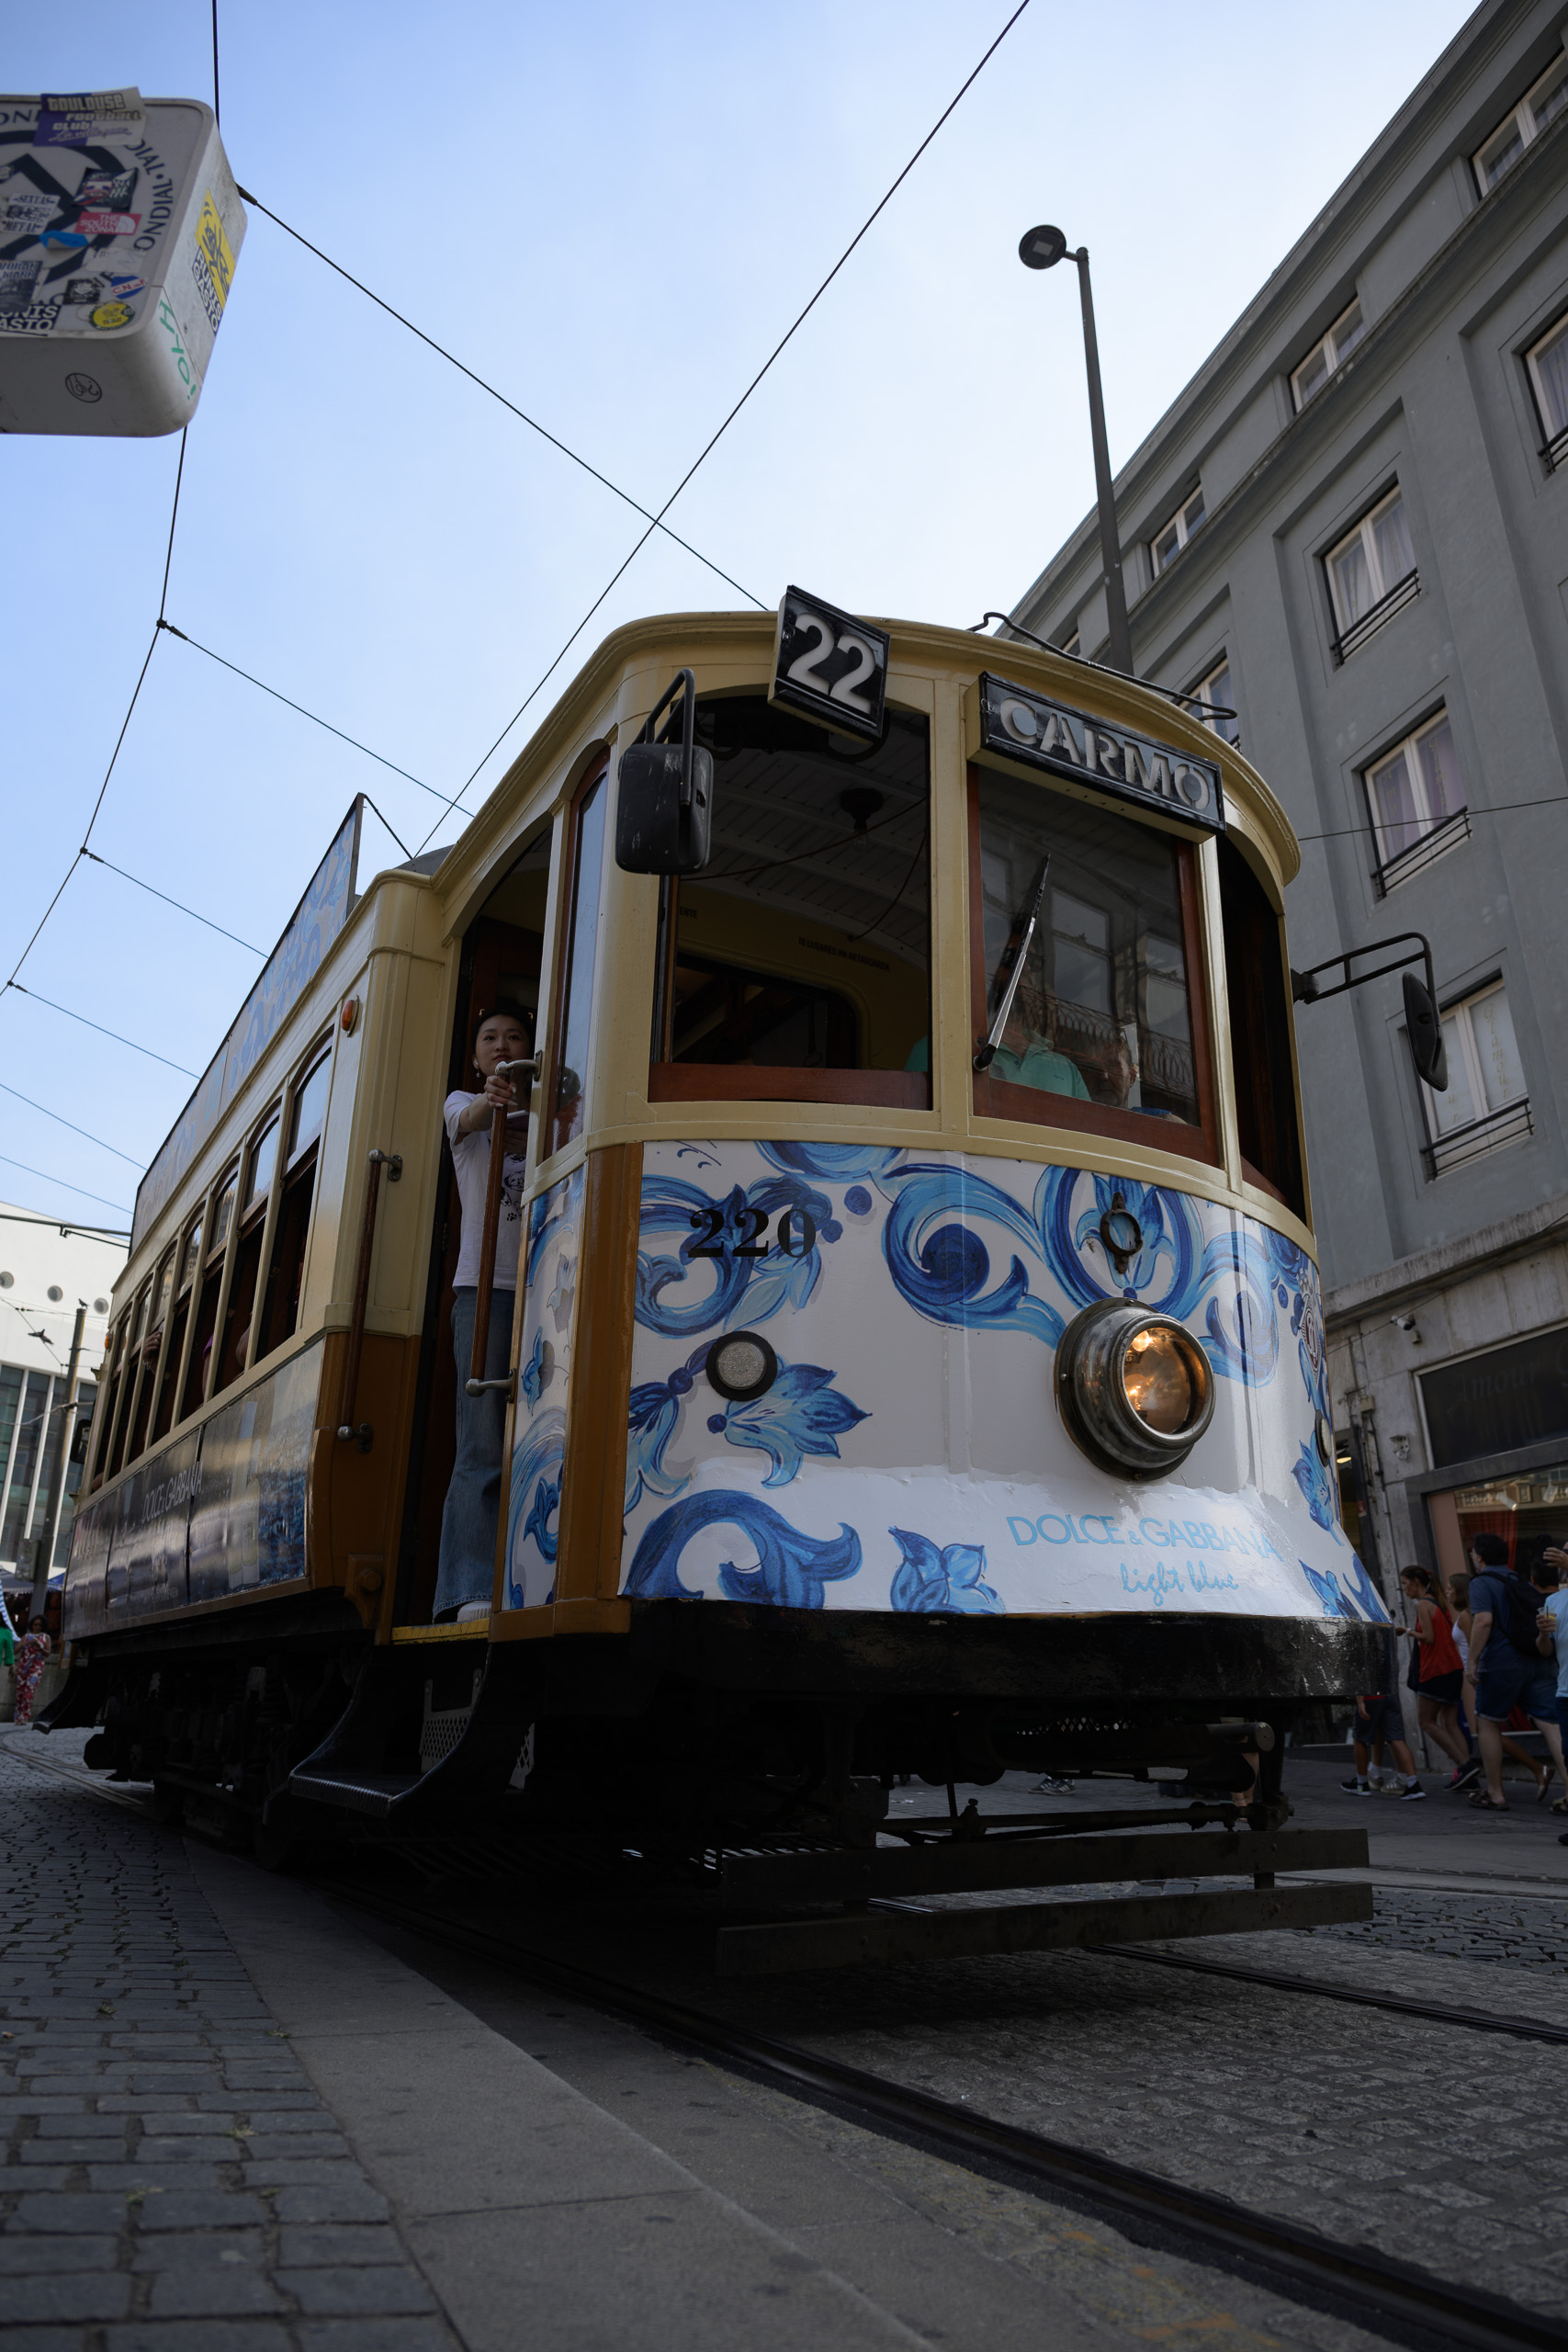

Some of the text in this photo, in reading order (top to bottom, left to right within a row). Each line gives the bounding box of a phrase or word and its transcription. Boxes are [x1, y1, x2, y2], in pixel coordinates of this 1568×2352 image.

[133, 178, 174, 252] ONDIAL
[787, 612, 876, 714] 22
[1000, 697, 1212, 810] CARMO
[680, 907, 698, 919] ENTE
[838, 948, 847, 958] NA
[688, 1208, 816, 1258] 220
[142, 1484, 164, 1524] DOLCE
[165, 1461, 203, 1511] GABBANA
[1007, 1513, 1284, 1562] DOLCE & GABBANA
[1121, 1560, 1239, 1607] light blue
